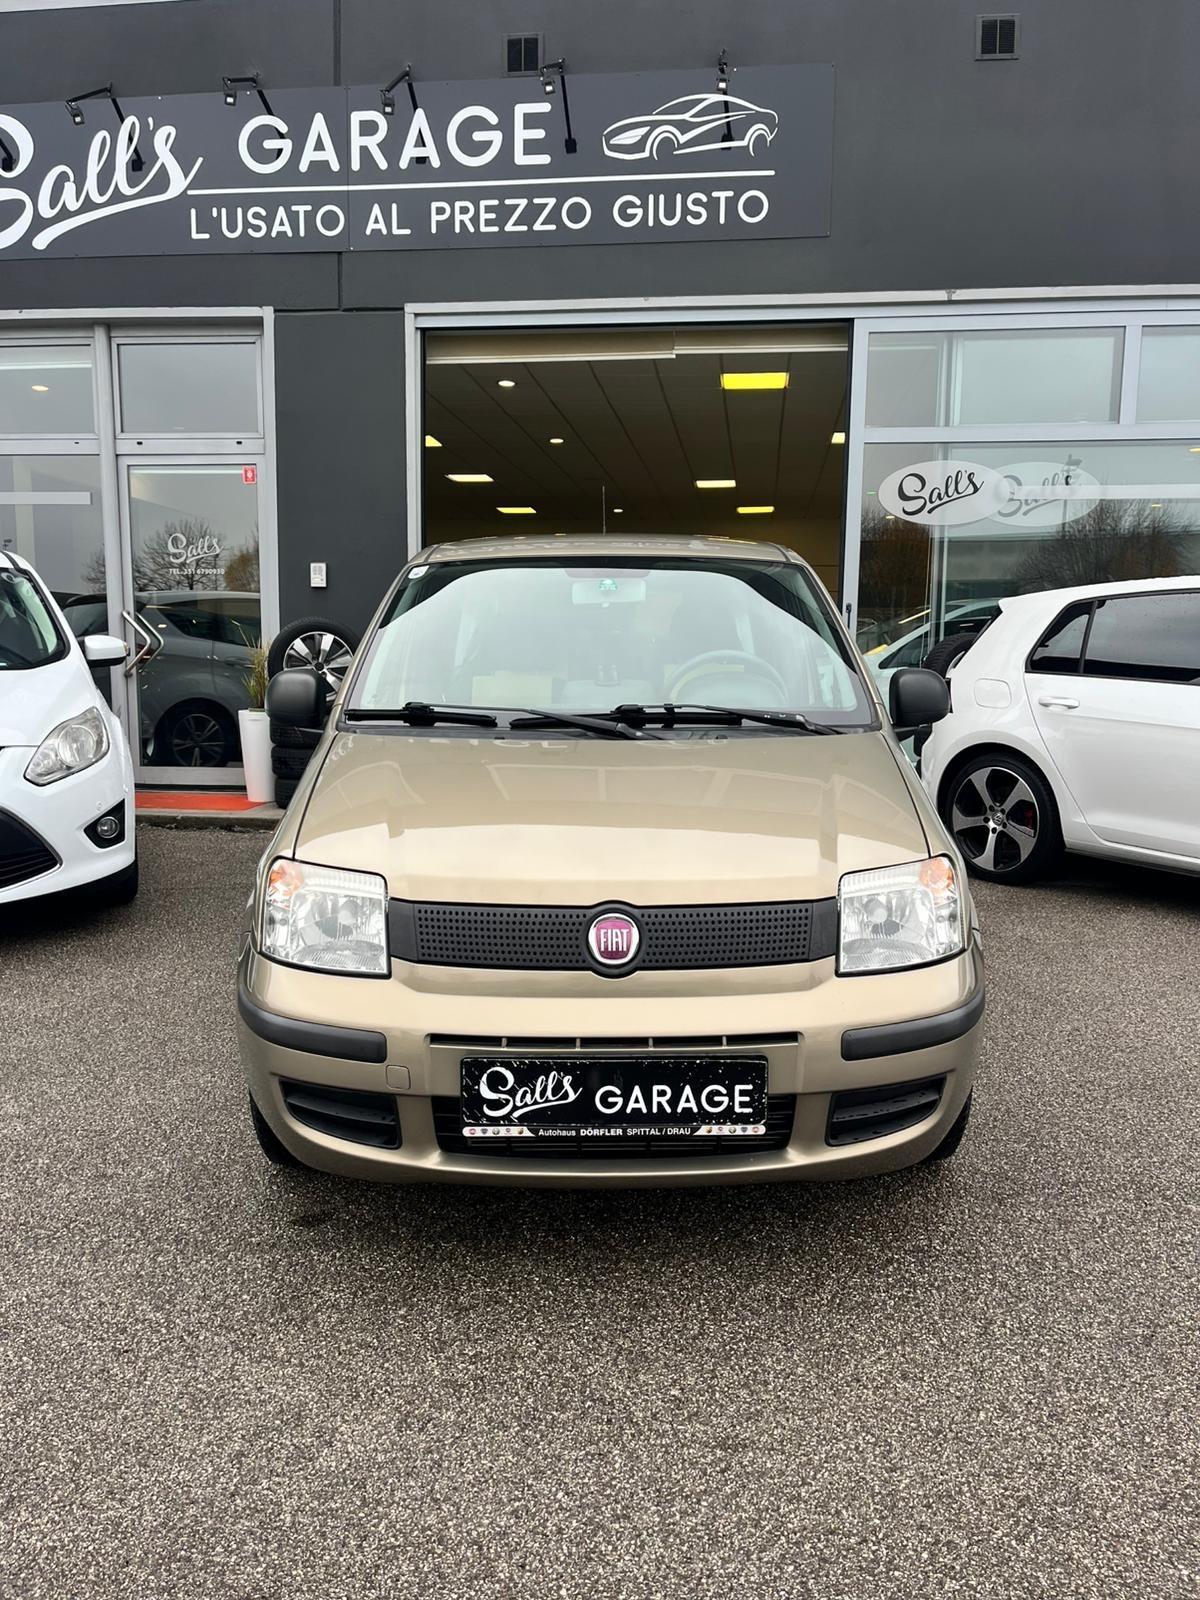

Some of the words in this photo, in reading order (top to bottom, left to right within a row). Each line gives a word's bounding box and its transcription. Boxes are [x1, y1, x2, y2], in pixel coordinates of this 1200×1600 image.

[238, 102, 552, 174] GARAGE
[190, 204, 346, 239] L'USATO
[365, 203, 411, 236] AL
[431, 196, 592, 234] PREZZO
[612, 190, 769, 228] GIUSTO
[898, 469, 984, 516] Sall's
[600, 928, 629, 952] FIAT
[594, 1084, 754, 1114] GARAGE
[538, 1128, 576, 1136] Autohaus
[580, 1127, 623, 1136] DÖRFLER
